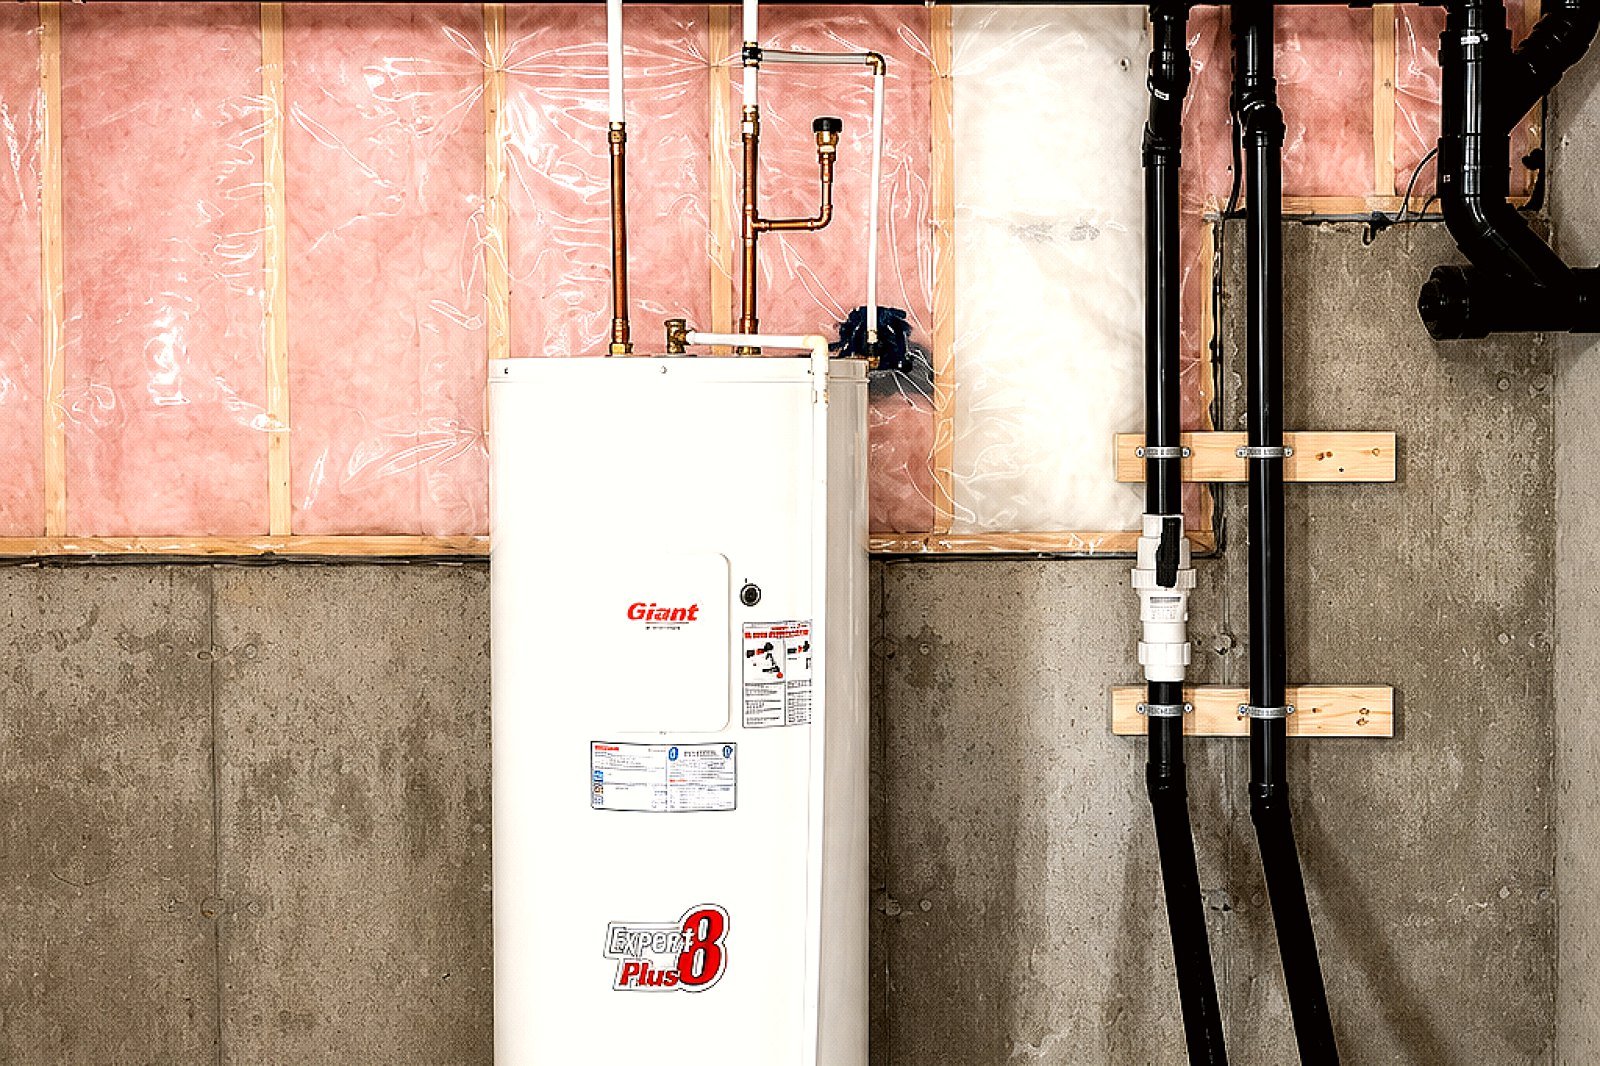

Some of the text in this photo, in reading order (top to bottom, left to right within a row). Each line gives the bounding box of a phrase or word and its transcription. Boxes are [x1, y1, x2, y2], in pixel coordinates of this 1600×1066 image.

[627, 602, 699, 621] Giant
[610, 909, 723, 985] Expert 8
[619, 962, 679, 986] Plus
